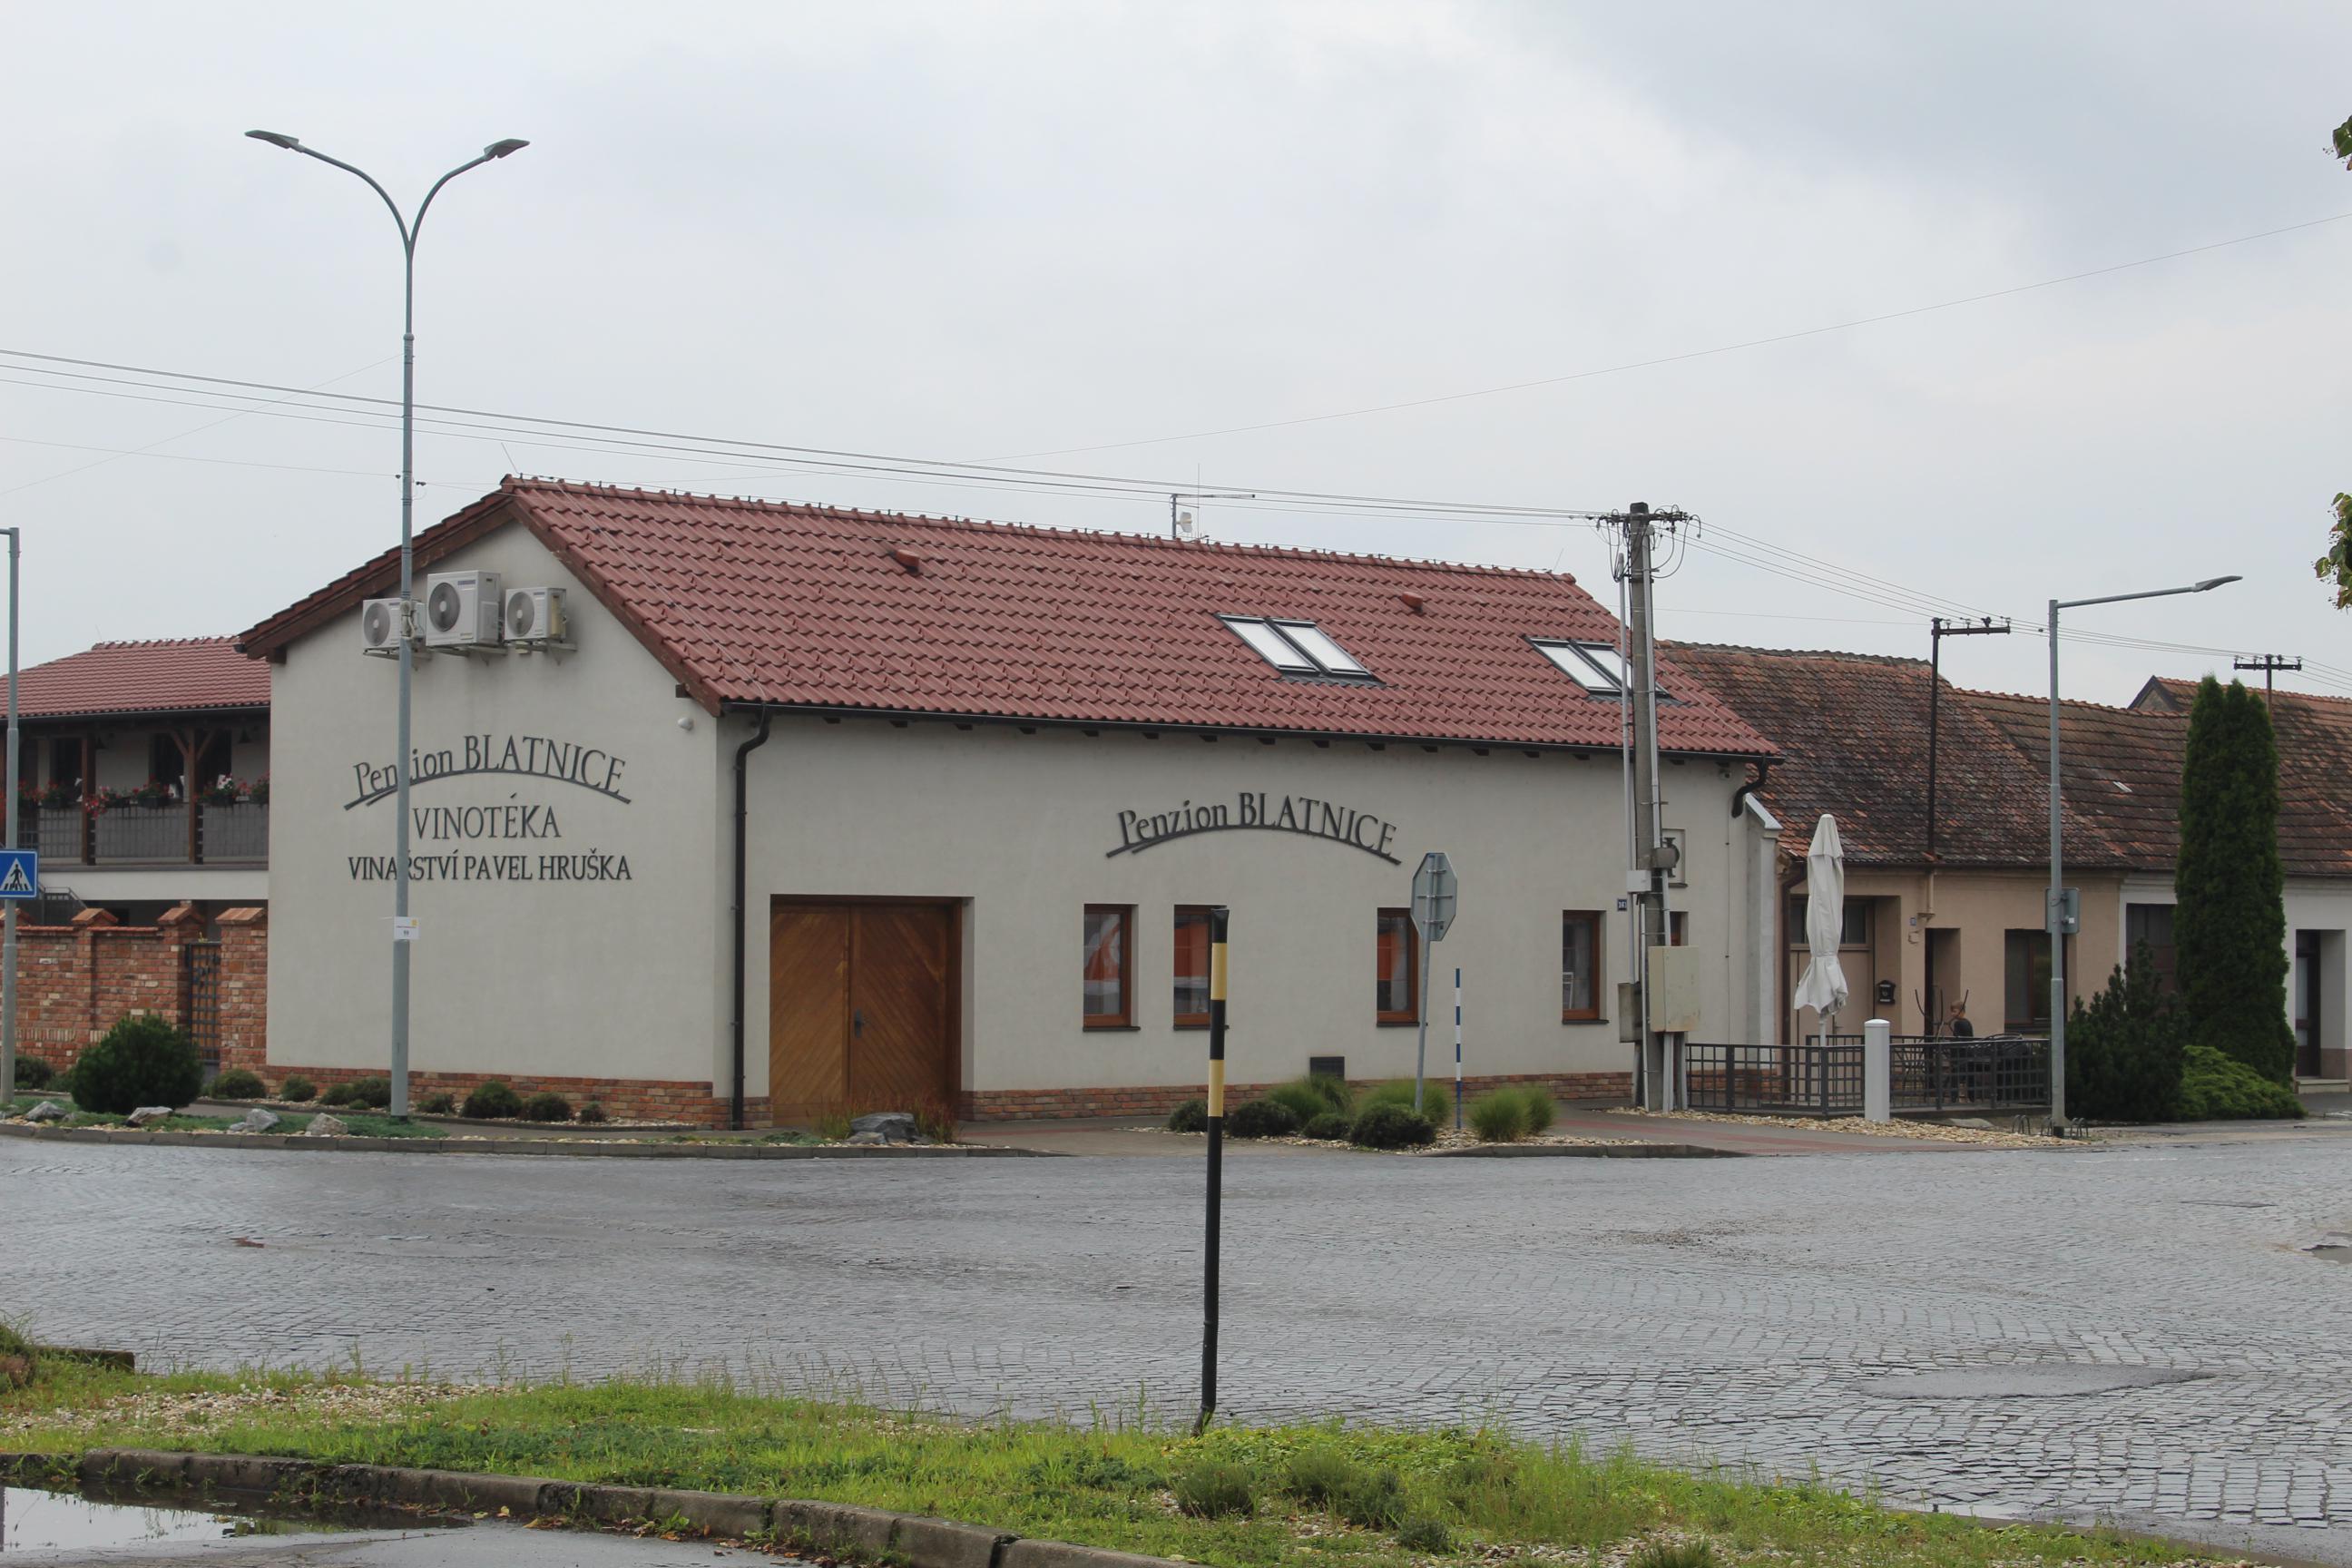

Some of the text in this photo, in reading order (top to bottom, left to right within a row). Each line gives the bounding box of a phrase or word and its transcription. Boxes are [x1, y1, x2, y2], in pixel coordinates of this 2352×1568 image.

[353, 734, 626, 799] Penion BLATNICE
[412, 792, 562, 839] VINOTÉKA
[1118, 792, 1397, 858] Penzion BLATNICE
[464, 855, 534, 880] PAVEL
[538, 848, 632, 880] HRUŠKA
